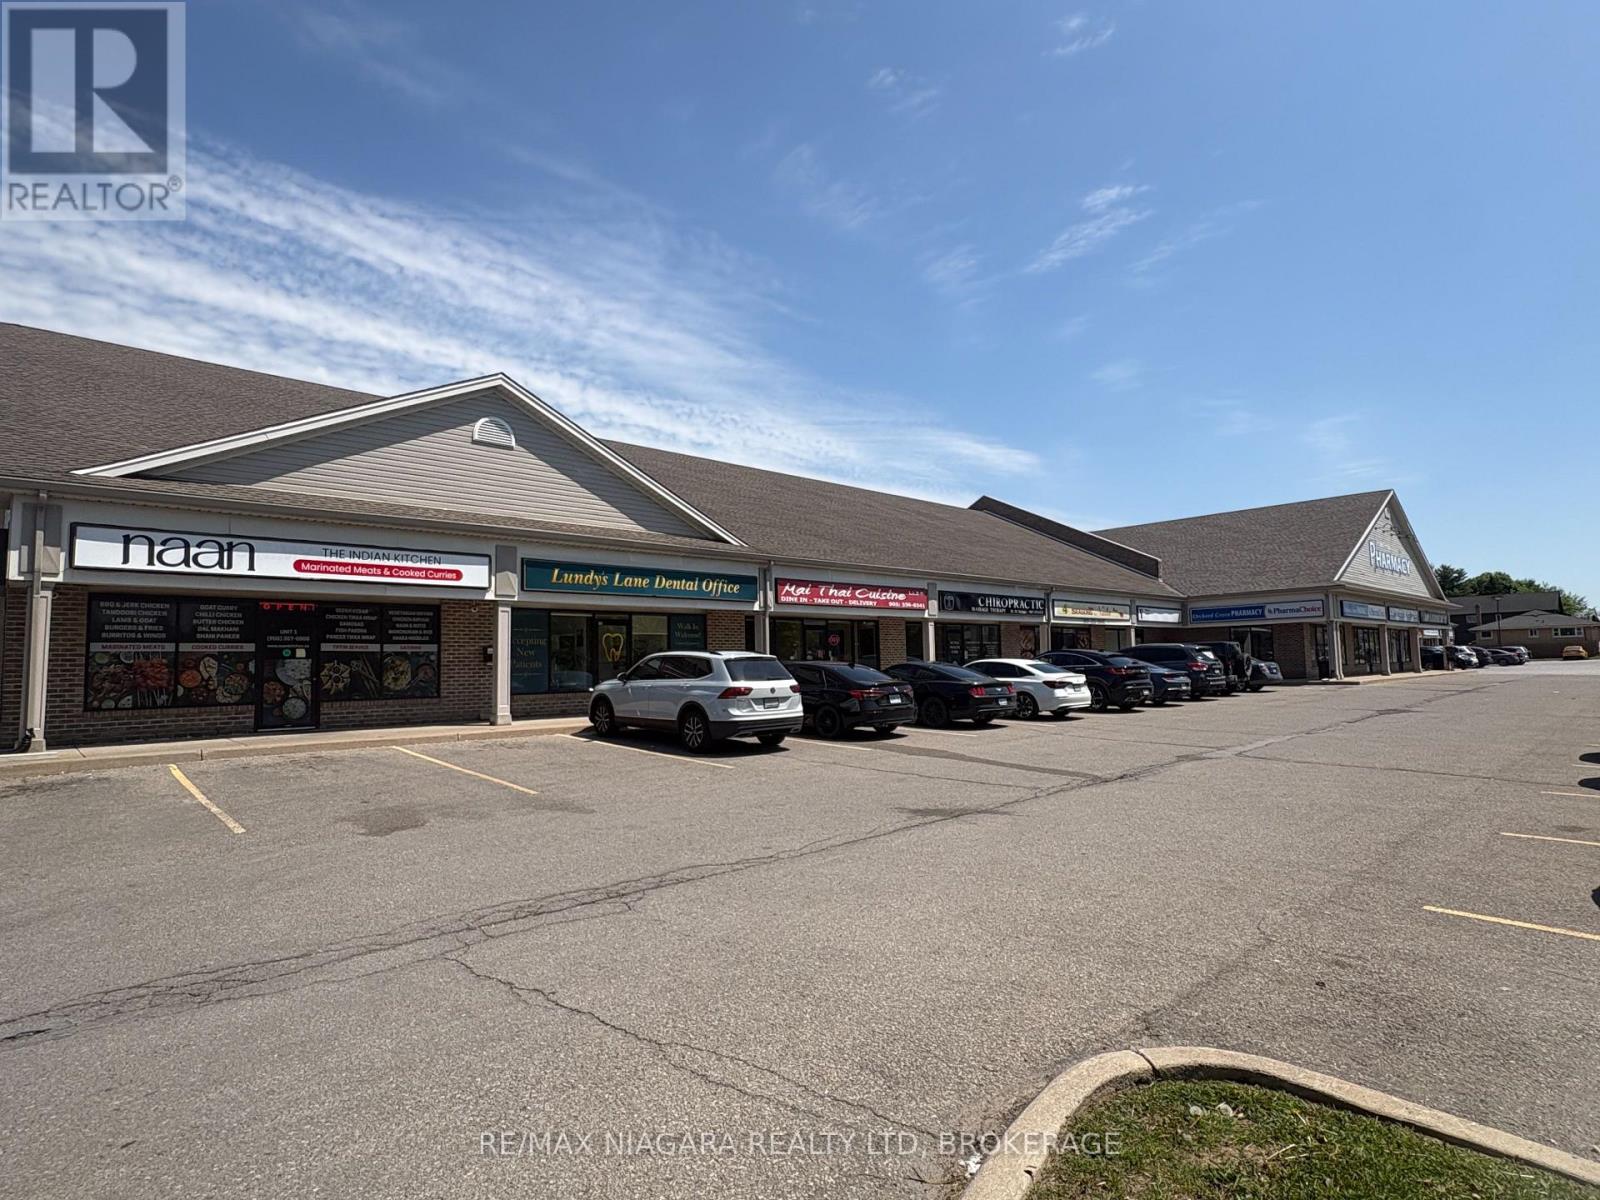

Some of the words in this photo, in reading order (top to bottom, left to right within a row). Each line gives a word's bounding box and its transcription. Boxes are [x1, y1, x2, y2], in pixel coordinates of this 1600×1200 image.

[121, 534, 255, 571] naan
[322, 548, 346, 559] THE
[349, 550, 391, 562] INDIAN
[394, 553, 442, 565] KITCHEN
[1369, 541, 1410, 576] PHARMACY
[301, 562, 351, 574] Marinated
[353, 566, 382, 575] Meats
[383, 567, 390, 576] &
[392, 568, 426, 578] Cooked
[427, 570, 457, 580] Curries
[551, 568, 609, 590] Lundy's
[613, 572, 650, 589] Lane
[654, 575, 698, 591] Dental
[702, 578, 740, 597] Office
[781, 582, 811, 597] Mai
[818, 584, 852, 597] Thai
[855, 587, 907, 601] Cuisine
[978, 596, 1045, 610] CHIROPRACTIC
[1231, 608, 1262, 617] PHARMACY
